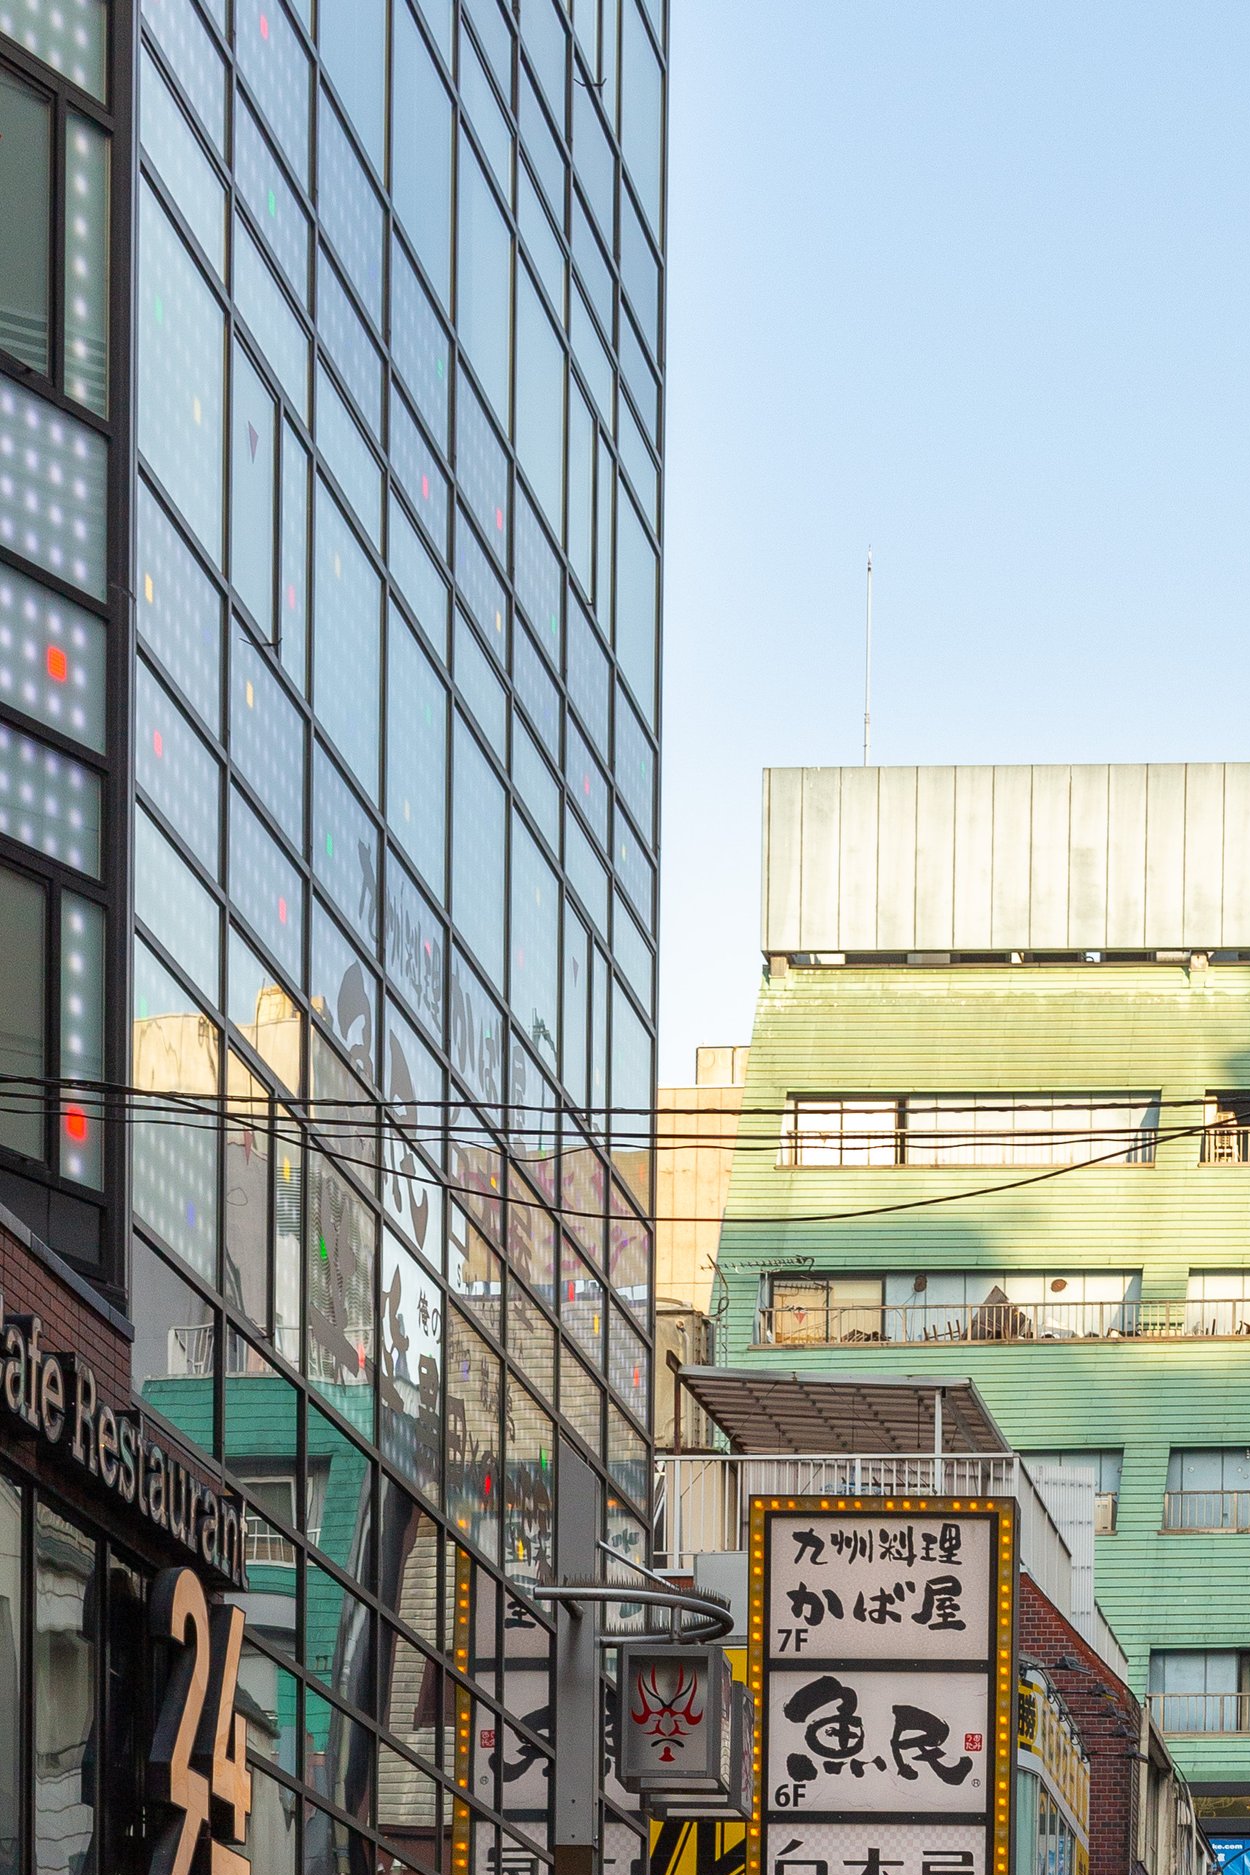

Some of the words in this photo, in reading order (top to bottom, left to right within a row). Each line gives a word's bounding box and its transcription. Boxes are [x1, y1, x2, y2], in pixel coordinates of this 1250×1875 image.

[72, 1358, 249, 1596] Restaurant
[791, 1525, 964, 1567] 九州料理
[785, 1575, 968, 1632] かば屋
[777, 1629, 809, 1653] 7F
[782, 1675, 975, 1782] 魚民
[773, 1783, 806, 1808] 6F
